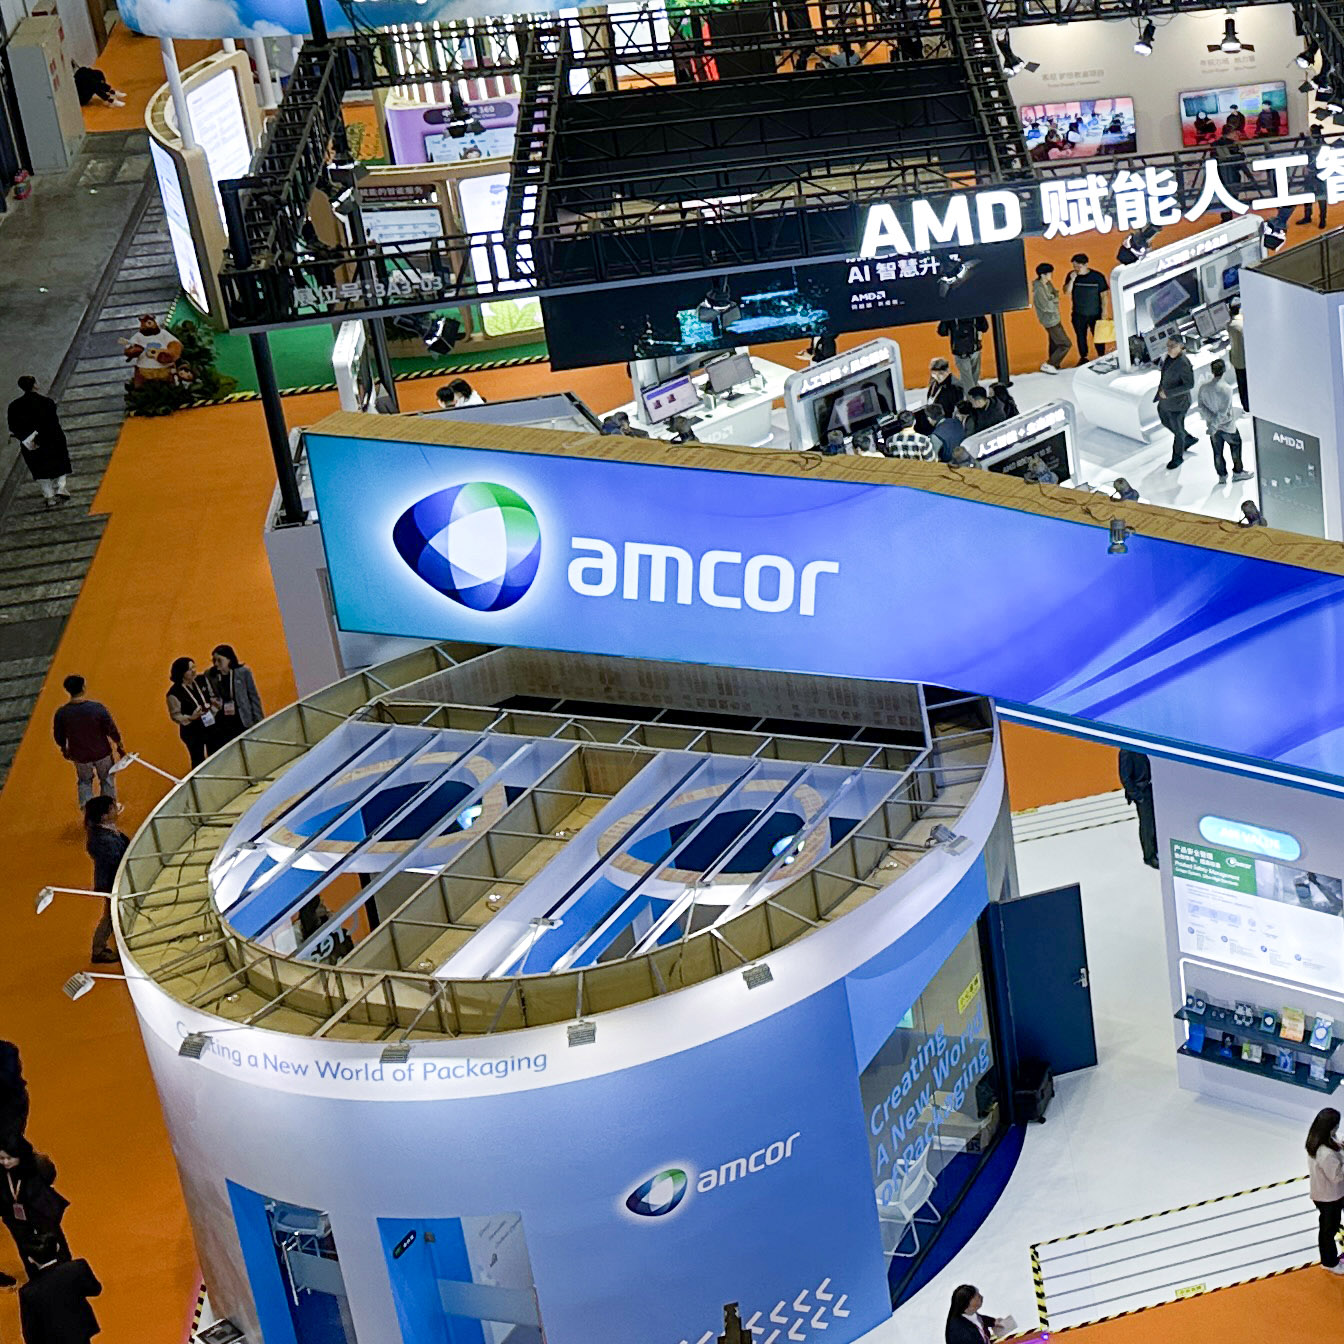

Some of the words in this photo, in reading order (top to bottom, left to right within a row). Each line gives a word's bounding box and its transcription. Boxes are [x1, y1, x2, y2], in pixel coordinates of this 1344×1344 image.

[860, 187, 1028, 260] AMD
[847, 269, 871, 284] AI
[851, 291, 878, 303] AMD
[567, 535, 840, 618] amcor
[248, 1052, 259, 1068] a
[263, 1052, 309, 1077] New
[315, 1059, 384, 1082] World
[393, 1058, 414, 1082] of
[423, 1052, 548, 1082] Packaging
[870, 1023, 945, 1137] Creating
[876, 1142, 890, 1177] A
[891, 1082, 931, 1153] New
[932, 999, 985, 1089] World
[695, 1132, 801, 1194] amcor
